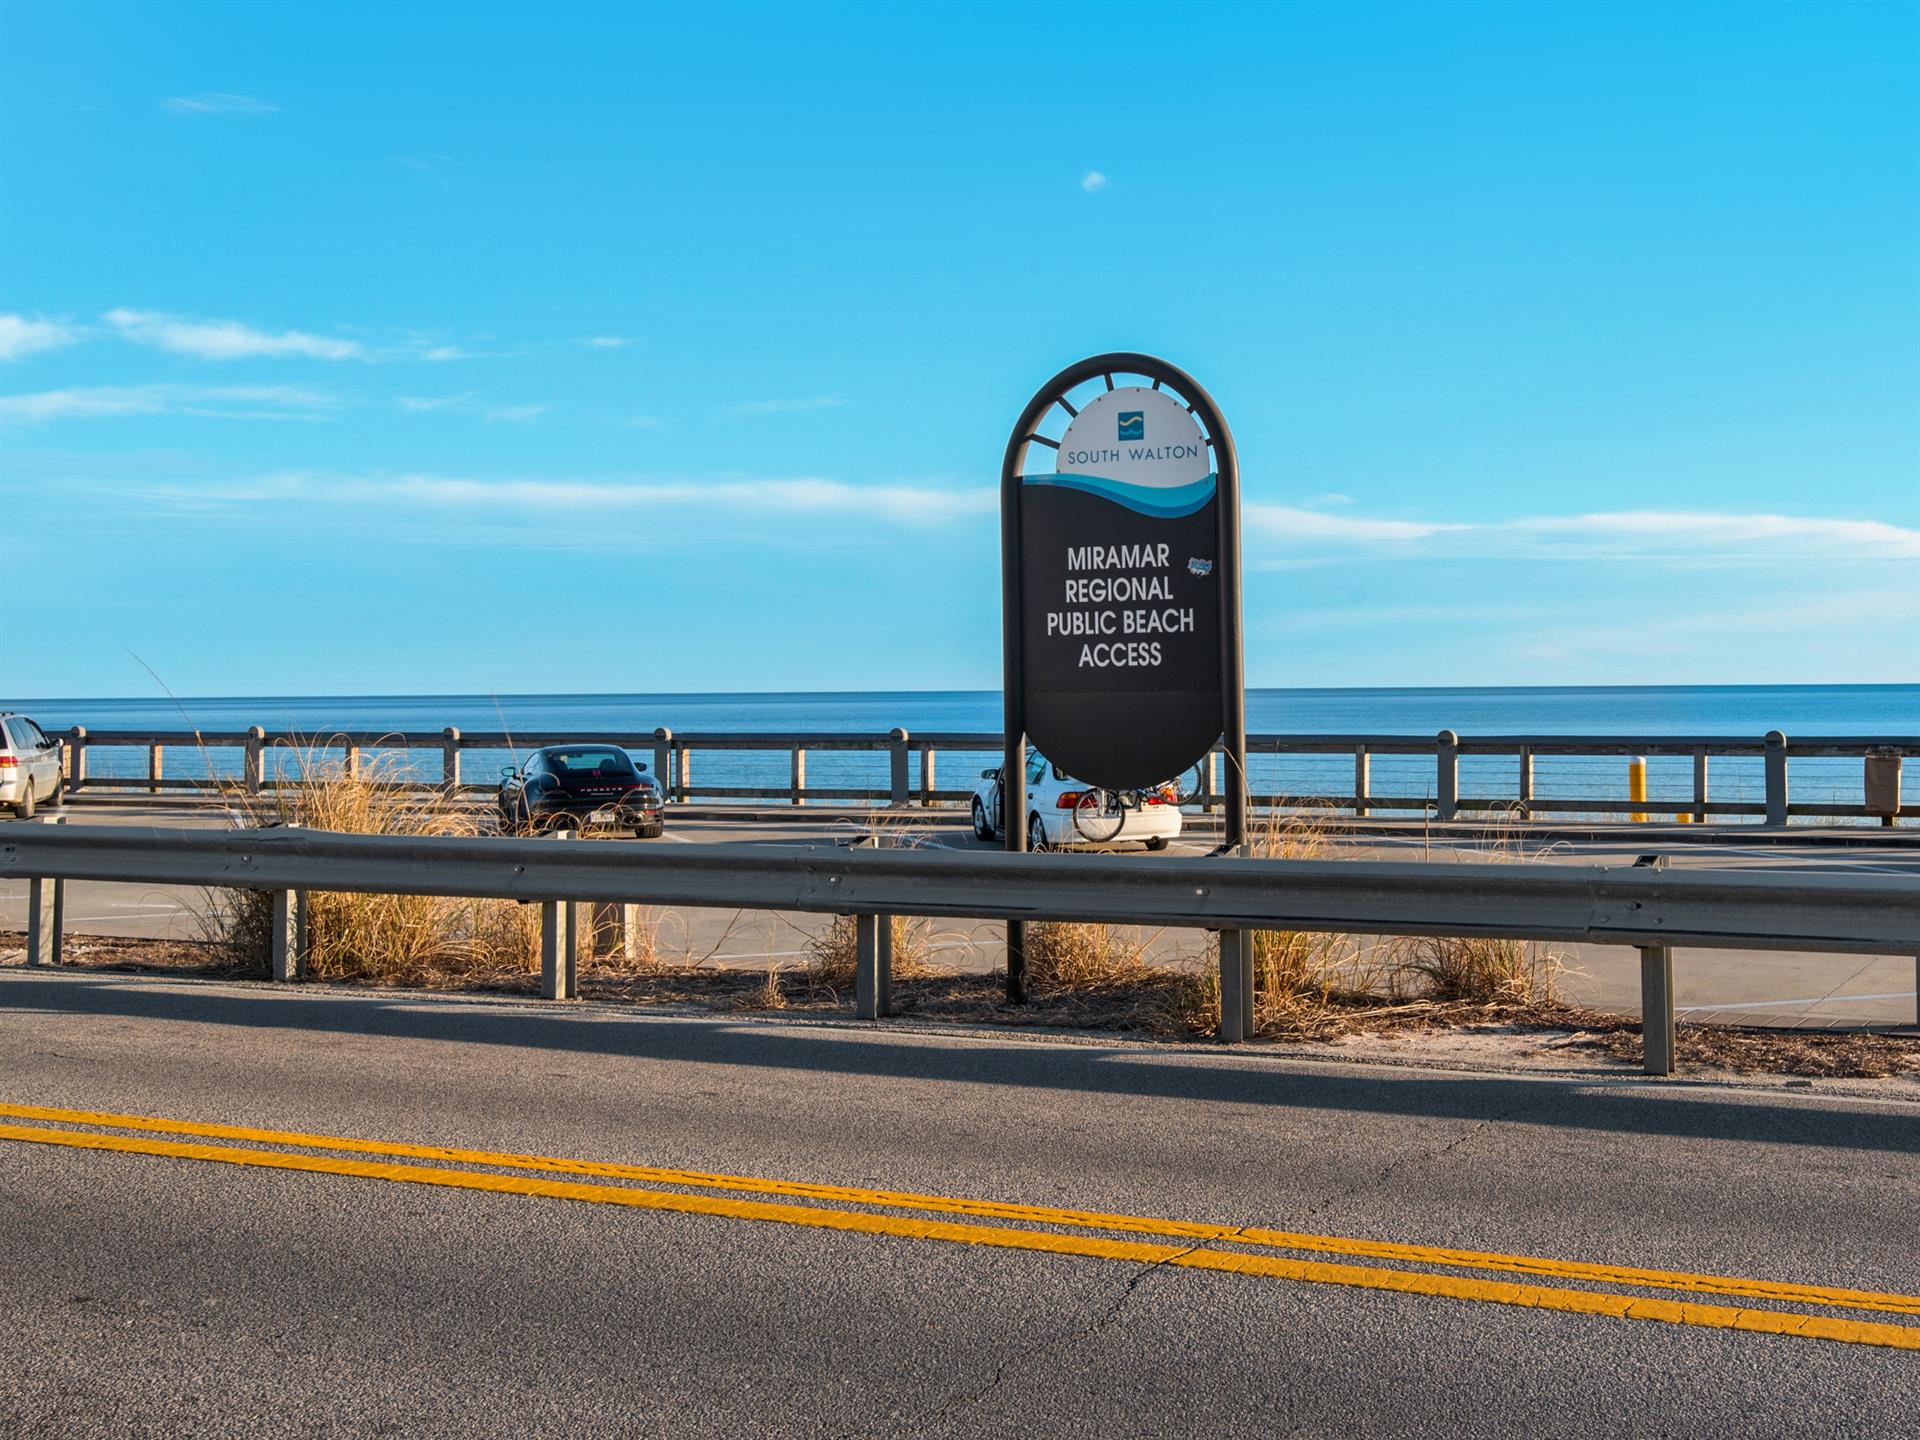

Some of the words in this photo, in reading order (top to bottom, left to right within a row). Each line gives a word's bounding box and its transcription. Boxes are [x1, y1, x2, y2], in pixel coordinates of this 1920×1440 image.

[1068, 451, 1120, 464] SOUTH
[1128, 445, 1198, 461] WALTON
[1067, 543, 1170, 571] MIRAMAR
[1065, 576, 1174, 603] REGIONAL
[1047, 611, 1117, 636] PUBLIC
[1123, 608, 1194, 634] BEACH
[1078, 642, 1162, 667] ACCESS
